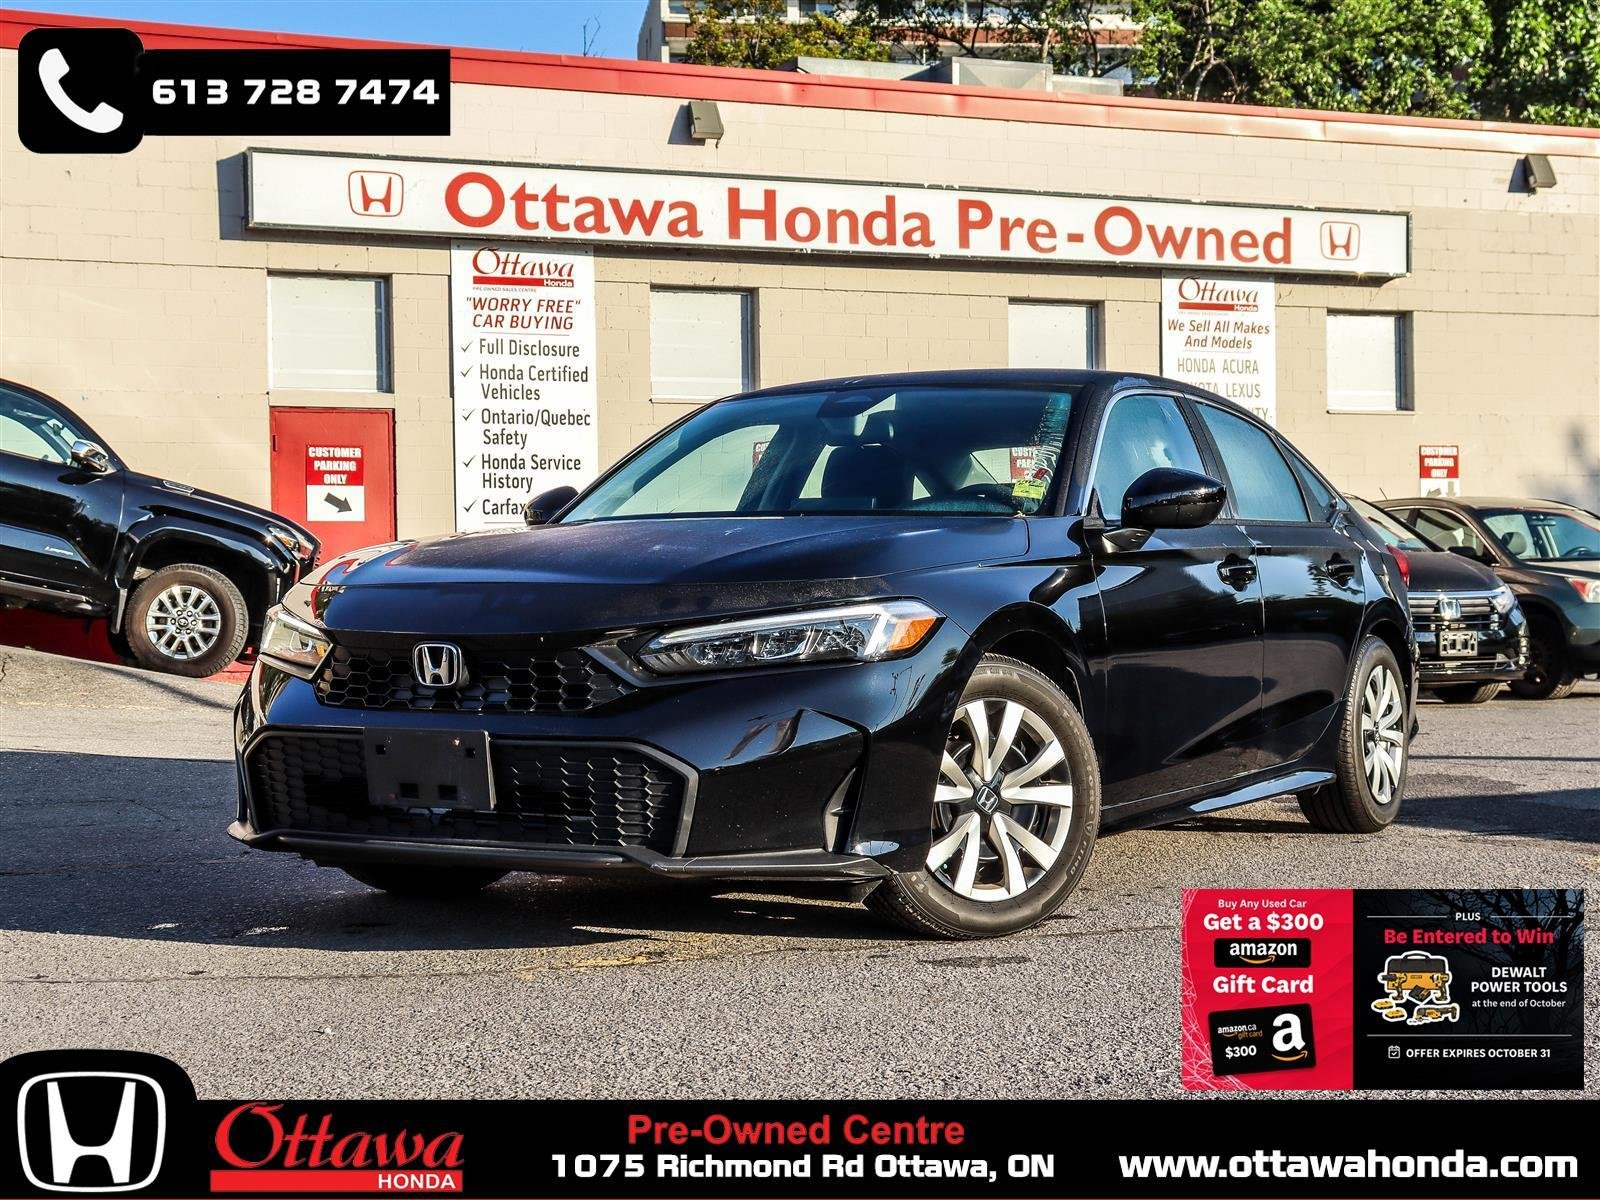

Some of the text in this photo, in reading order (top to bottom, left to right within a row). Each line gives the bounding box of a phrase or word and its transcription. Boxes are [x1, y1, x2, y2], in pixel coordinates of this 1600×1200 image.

[445, 171, 703, 238] Ottawa
[728, 187, 935, 248] Honda
[472, 247, 574, 277] Ottawa
[543, 278, 573, 287] Honda
[1178, 276, 1259, 303] Ottawa
[466, 297, 581, 313] "WORRY FREE"
[472, 314, 574, 330] CAR BUYING
[1167, 319, 1270, 335] We Sell All Makes
[480, 338, 580, 357] Full Disclosure
[1184, 335, 1252, 349] And Models
[480, 363, 588, 383] Honda Certified
[1177, 357, 1259, 374] HONDA ACURA
[481, 383, 541, 400] Vehicles
[1225, 383, 1261, 399] LEXUS
[481, 408, 591, 427] Ontario/Quebec
[483, 428, 527, 450] Safety
[308, 446, 362, 458] CUSTOMER
[313, 460, 357, 471] PARKING
[482, 453, 581, 470] Honda Service
[323, 473, 347, 485] ONLY
[482, 473, 533, 493] History
